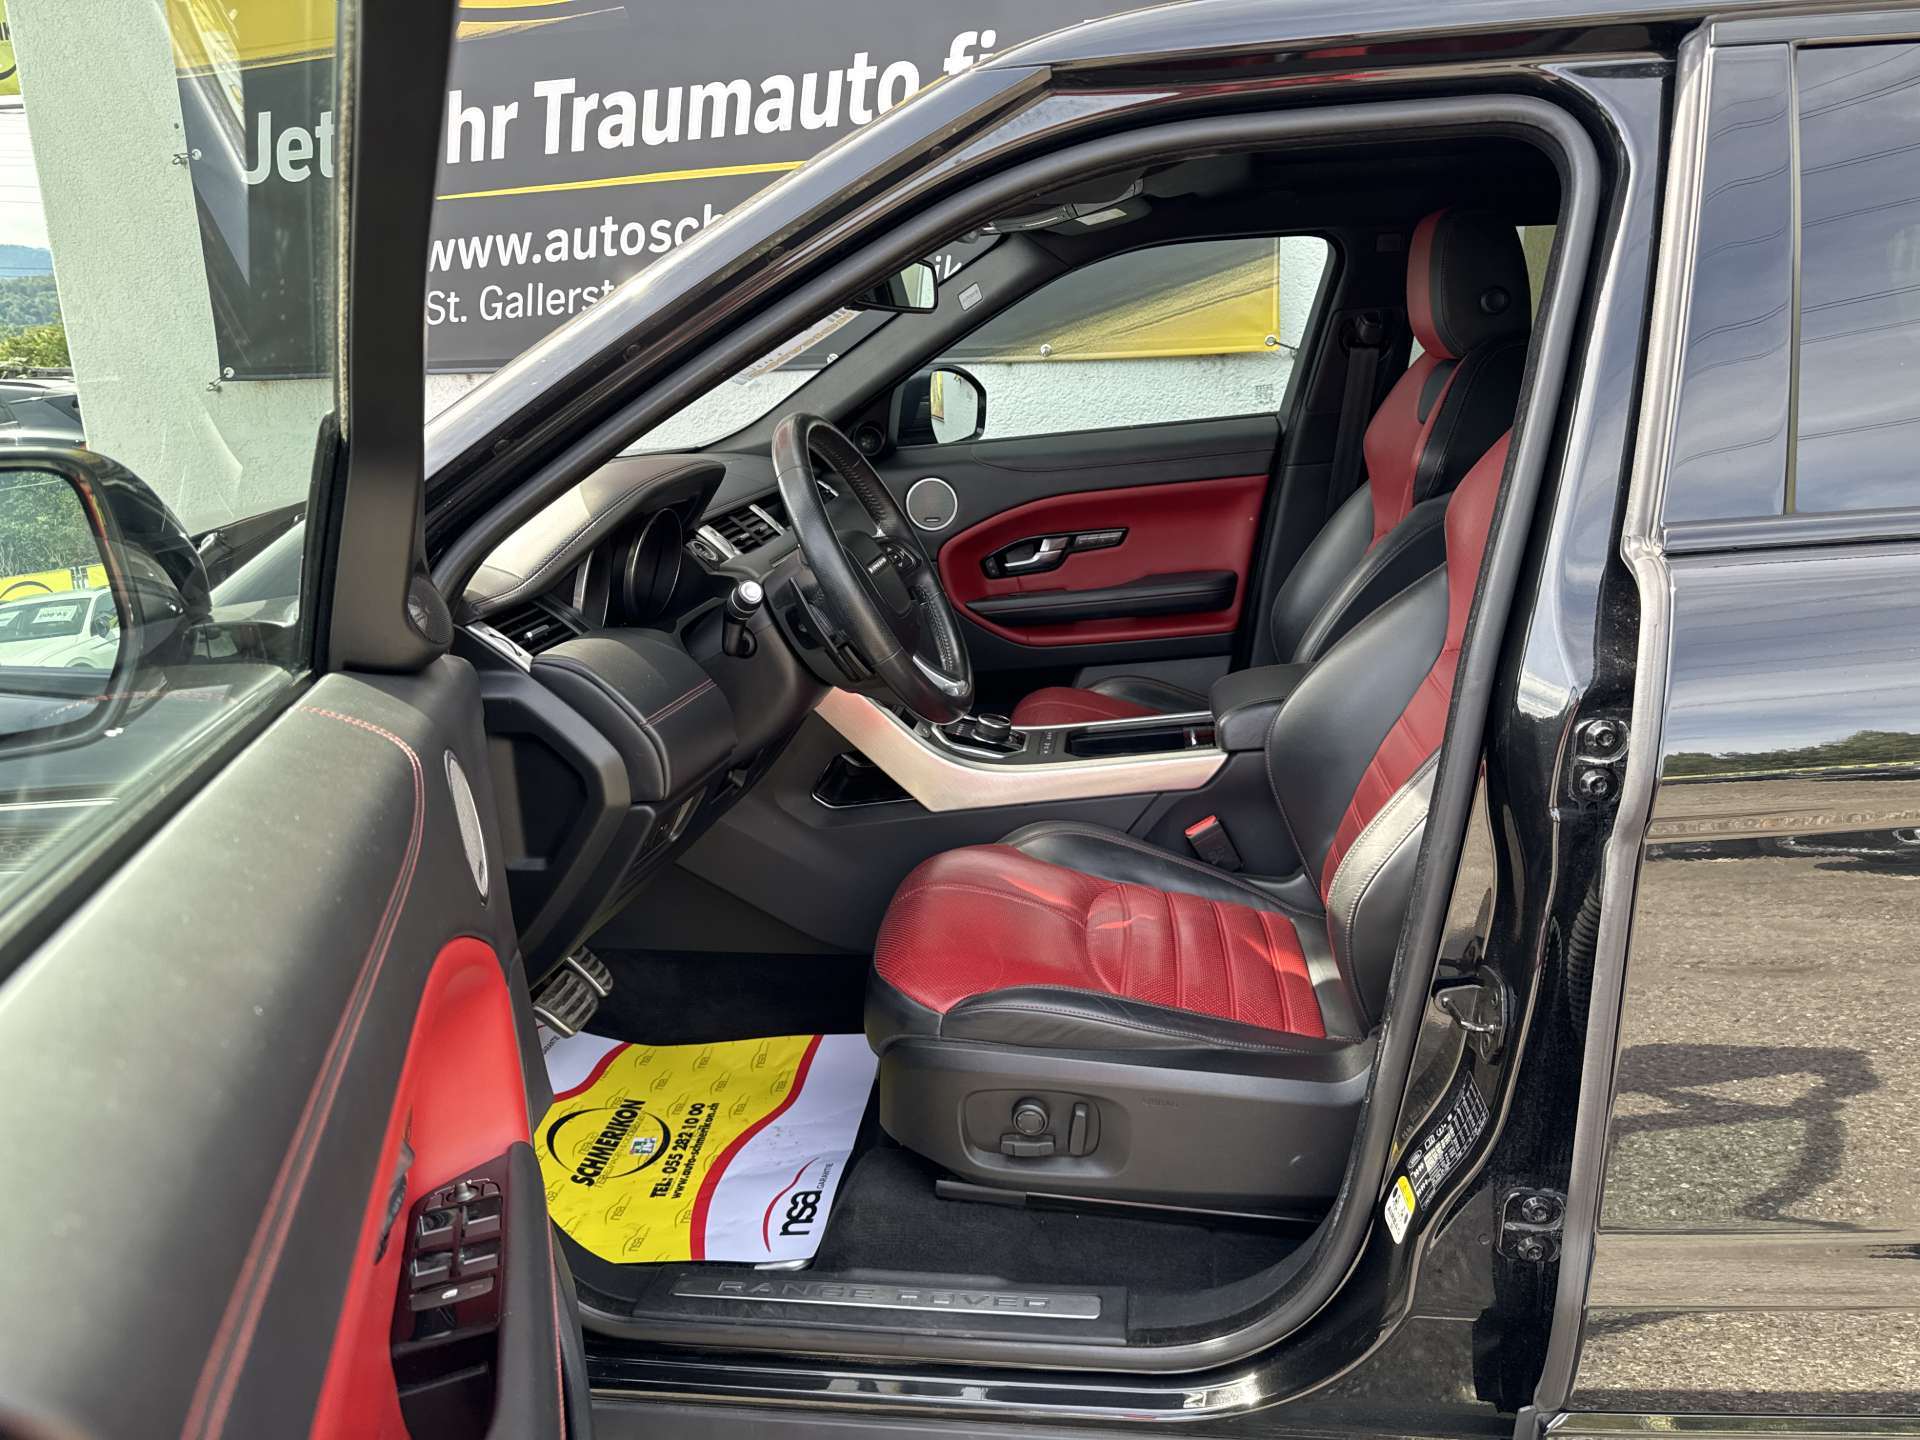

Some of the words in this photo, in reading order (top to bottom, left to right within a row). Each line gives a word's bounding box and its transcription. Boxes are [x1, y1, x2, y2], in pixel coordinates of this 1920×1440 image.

[534, 52, 920, 155] Traumauto
[426, 290, 468, 325] St.
[688, 1103, 706, 1116] 00
[682, 1117, 699, 1130] 10
[570, 1098, 646, 1187] SCHMERIKON
[673, 1132, 693, 1152] 282
[662, 1153, 684, 1175] 055
[650, 1178, 673, 1198] TEL:
[779, 1190, 823, 1236] nsa
[717, 1280, 875, 1299] RANGE
[896, 1289, 1051, 1310] ROVER
